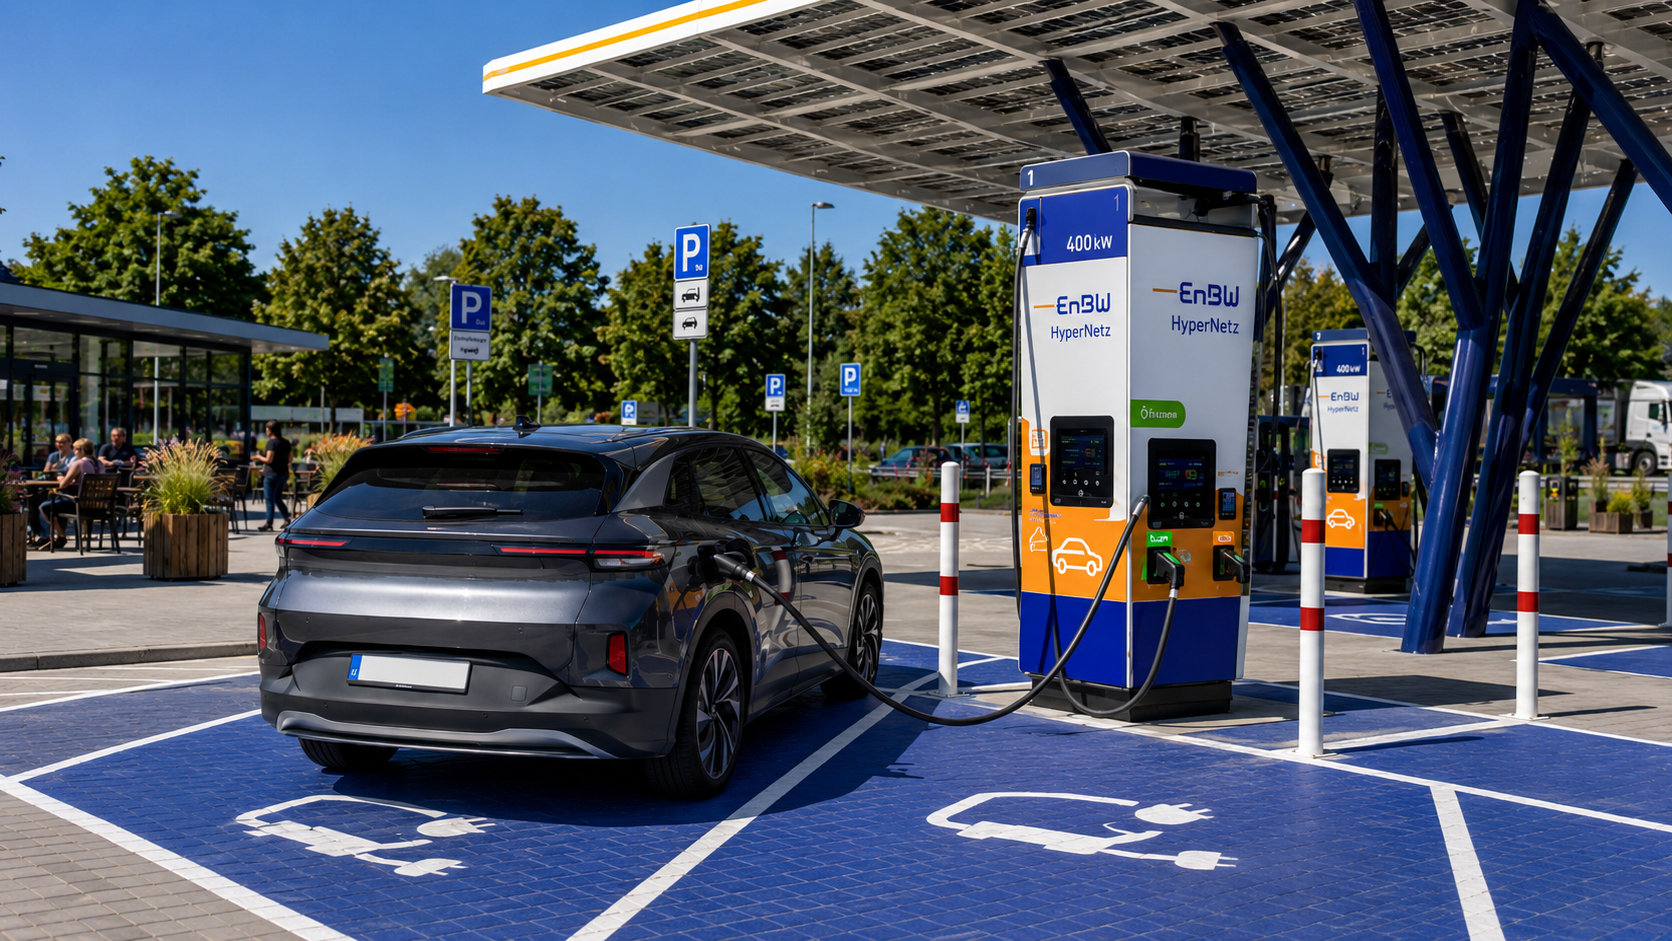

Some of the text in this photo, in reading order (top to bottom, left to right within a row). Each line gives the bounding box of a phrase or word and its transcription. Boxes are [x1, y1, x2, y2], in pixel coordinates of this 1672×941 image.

[1027, 169, 1034, 186] 1
[1113, 194, 1119, 212] 1
[682, 233, 701, 272] P
[1056, 293, 1111, 315] EnBW
[1179, 282, 1240, 308] EnBW
[461, 291, 482, 324] P
[1051, 324, 1111, 342] HyperNetz
[1171, 315, 1240, 336] HyperNetz
[770, 377, 781, 395] P
[844, 367, 857, 387] P
[1330, 391, 1360, 402] EnBW
